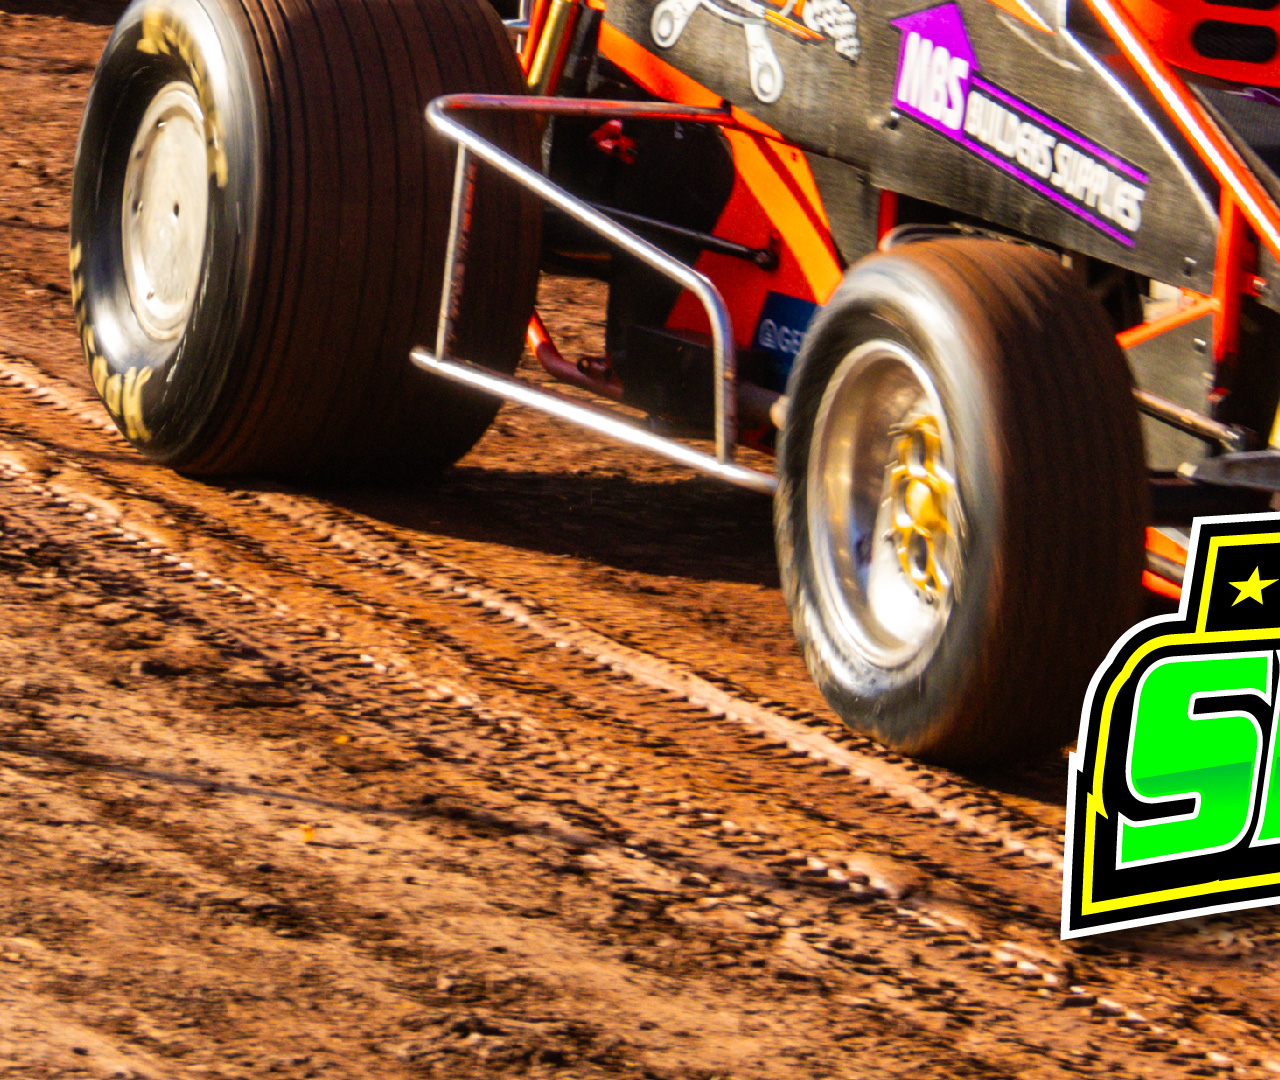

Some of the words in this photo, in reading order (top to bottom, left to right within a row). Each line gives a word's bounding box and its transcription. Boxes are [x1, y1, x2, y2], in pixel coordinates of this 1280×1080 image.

[897, 31, 969, 130] MBS
[964, 89, 1056, 179] BUILDERS
[1049, 142, 1147, 232] SUPPLIES
